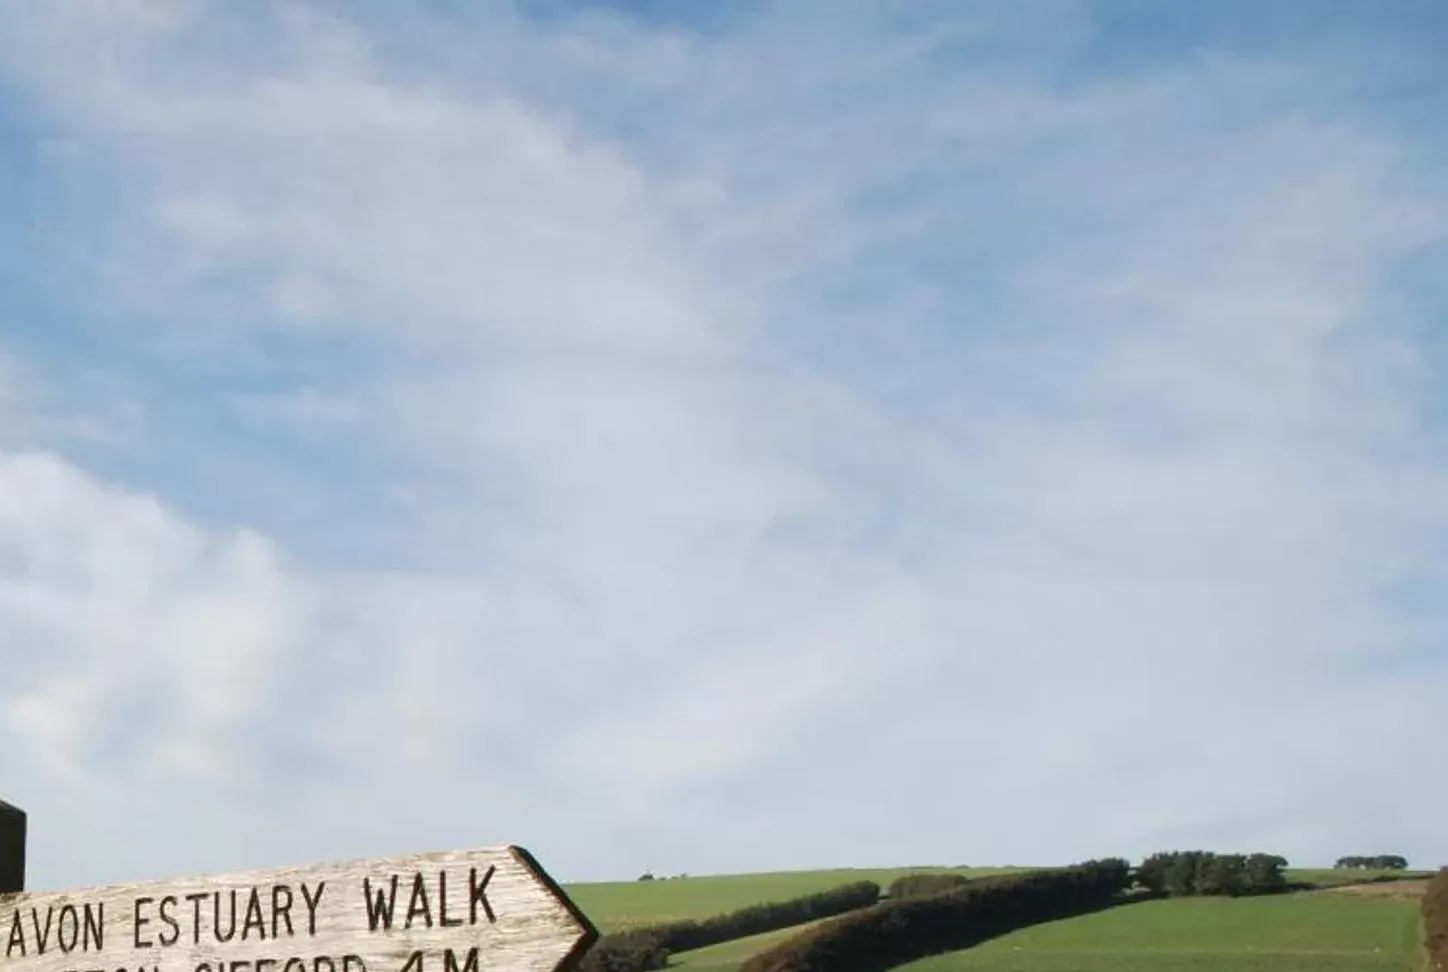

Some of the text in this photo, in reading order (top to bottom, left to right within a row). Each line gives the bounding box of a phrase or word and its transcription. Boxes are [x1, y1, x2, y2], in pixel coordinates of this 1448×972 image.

[6, 864, 497, 959] AVON ESTUARY WALK
